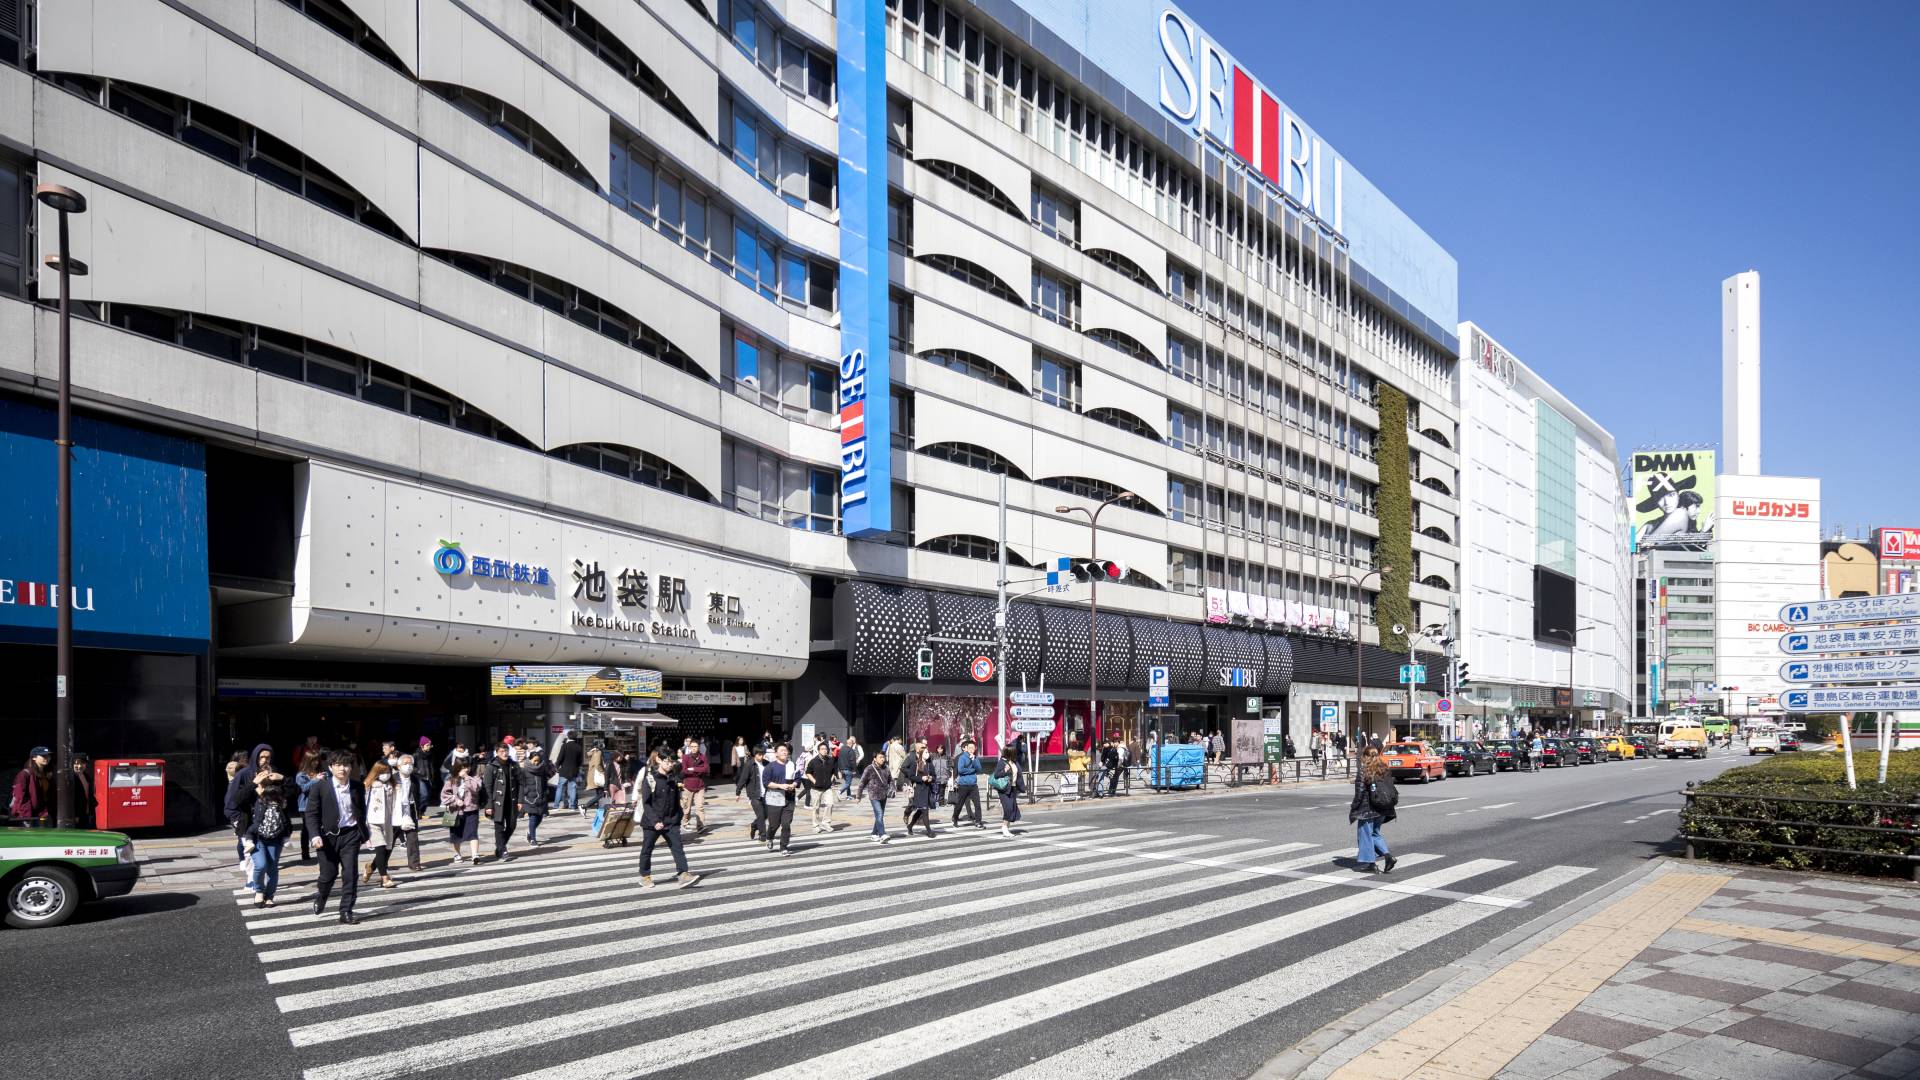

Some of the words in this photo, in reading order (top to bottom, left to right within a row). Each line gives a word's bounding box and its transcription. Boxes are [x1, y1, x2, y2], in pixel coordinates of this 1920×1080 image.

[1158, 8, 1343, 236] SEIBU
[840, 348, 868, 510] SEIBU
[1635, 453, 1696, 472] DMM
[1732, 500, 1809, 518] ビックカメラ
[471, 555, 549, 586] 西武鉄道
[571, 558, 686, 616] 池袋駅
[708, 591, 741, 616] 東口
[571, 610, 645, 634] Ikebukuro
[651, 621, 697, 641] Station
[1748, 623, 1760, 632] BIC
[1815, 628, 1918, 644] 池袋職業安定所
[1812, 659, 1919, 672] 労働相談情報センター
[1153, 668, 1165, 685] P
[1220, 666, 1257, 688] SEIBU
[1814, 690, 1918, 701] 豊島区総合運動場
